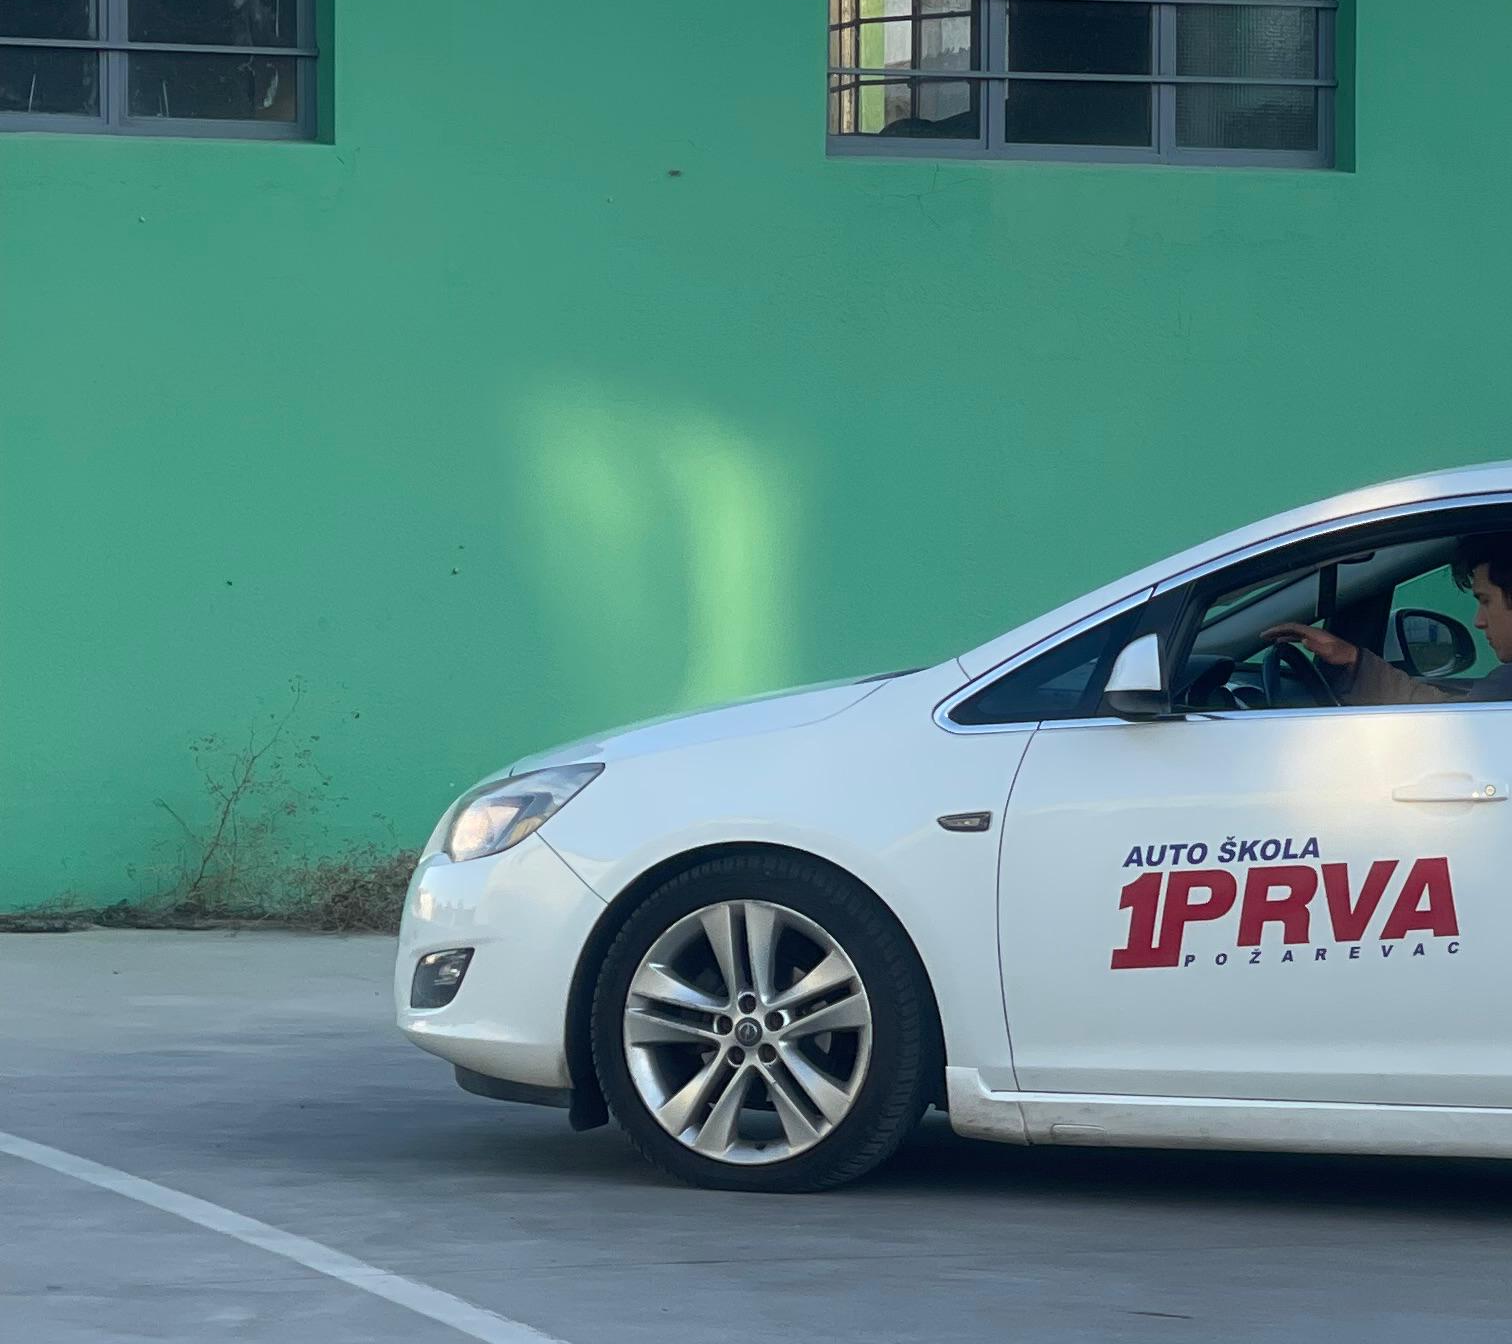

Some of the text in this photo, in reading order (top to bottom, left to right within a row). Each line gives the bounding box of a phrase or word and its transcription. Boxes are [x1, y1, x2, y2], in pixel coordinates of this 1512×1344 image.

[1121, 836, 1320, 868] AUTO ŠKOLA
[1184, 941, 1460, 968] POŽAREVAC
